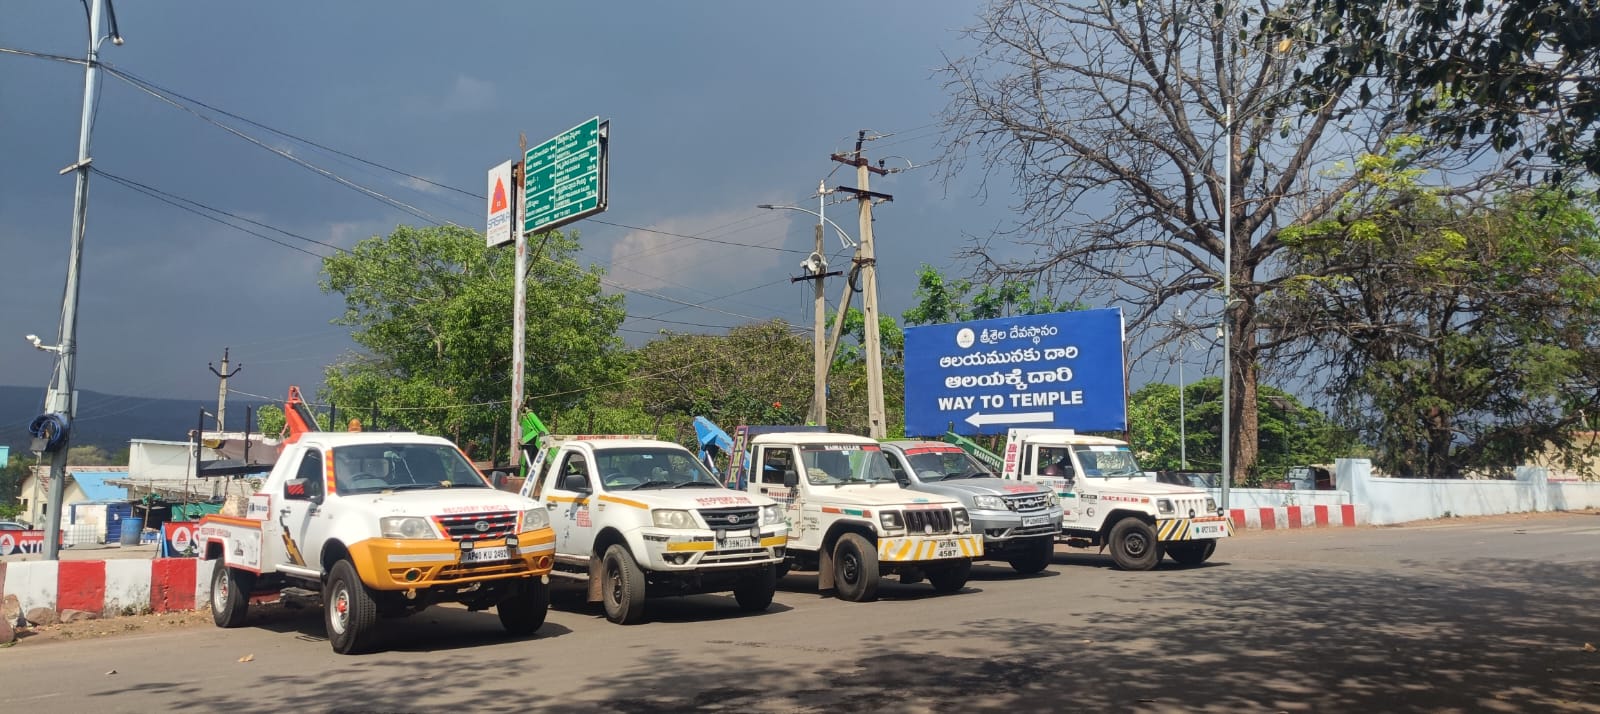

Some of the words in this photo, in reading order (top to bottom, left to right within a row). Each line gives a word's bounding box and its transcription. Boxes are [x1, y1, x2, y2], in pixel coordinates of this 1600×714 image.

[979, 328, 1007, 344] శ్రీశైల
[1009, 324, 1058, 345] దేవస్థానం
[939, 347, 1041, 368] ఆలయమునకు
[1043, 345, 1079, 361] దారి
[938, 395, 974, 411] WAY
[980, 394, 1004, 409] TO
[1009, 390, 1083, 407] TEMPLE
